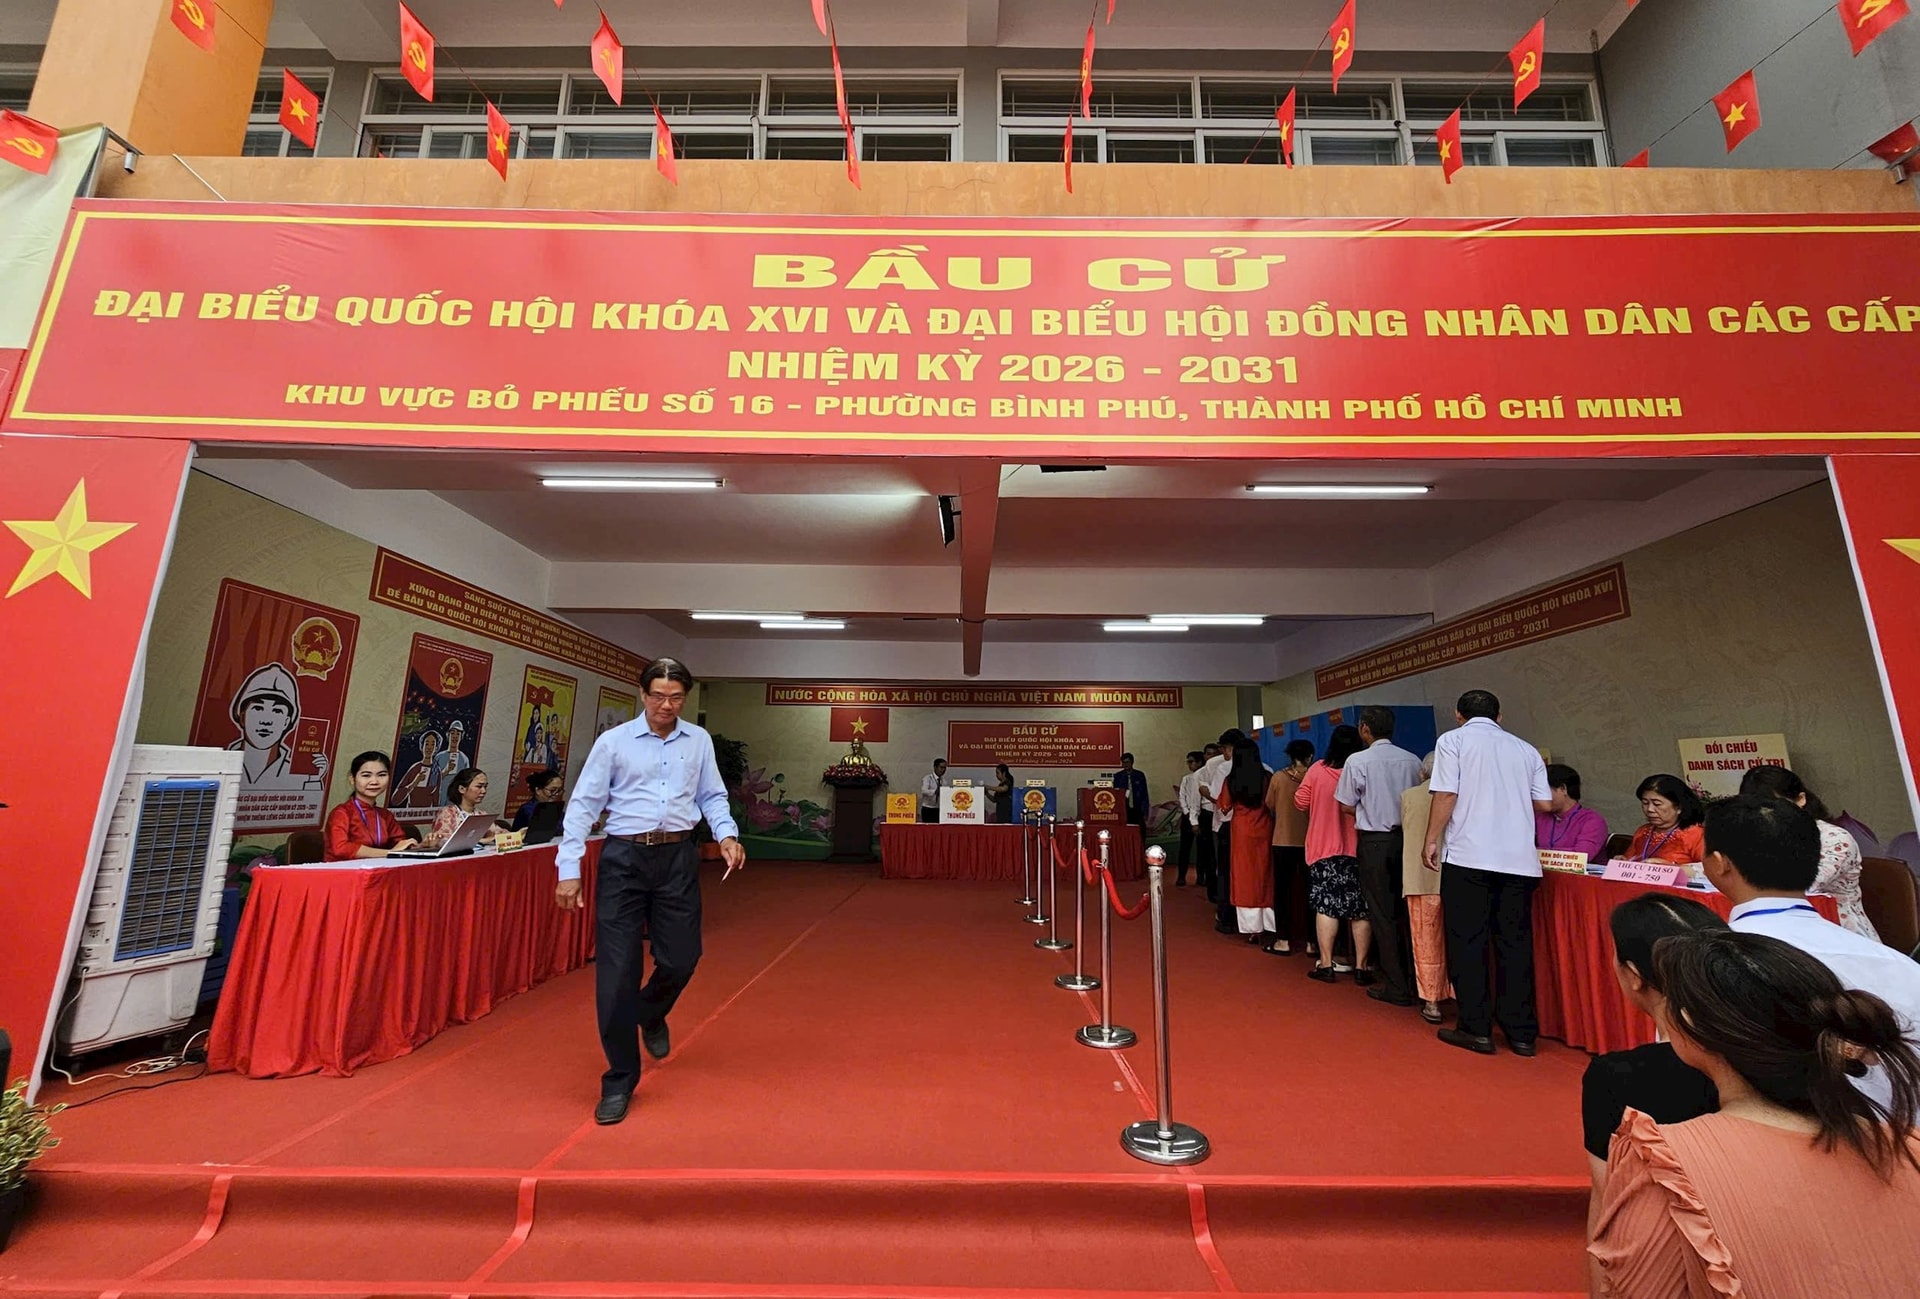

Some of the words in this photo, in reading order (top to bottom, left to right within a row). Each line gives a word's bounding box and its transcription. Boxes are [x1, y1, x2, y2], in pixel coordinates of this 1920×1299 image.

[753, 245, 1031, 291] BẦU
[1089, 247, 1286, 292] CỬ
[94, 290, 184, 323] ĐẠI
[198, 285, 318, 321] BIỂU
[335, 290, 473, 326] QUỐC
[489, 296, 575, 334] HỘI
[592, 299, 729, 331] KHÓA
[748, 306, 828, 332] XVI
[847, 302, 910, 334] VÀ
[928, 308, 1012, 340] ĐẠI
[1032, 299, 1146, 336] BIỂU
[1166, 304, 1248, 341] HỘI
[1268, 301, 1407, 337] ĐỒNG
[1425, 304, 1568, 336] NHÂN
[1585, 303, 1691, 335] DÂN
[1709, 301, 1810, 333] CÁC
[1827, 297, 1920, 332] CẤP
[728, 347, 899, 386] NHIỆM
[918, 348, 981, 382] KỲ
[1000, 354, 1125, 382] 2026
[1180, 356, 1297, 383] 2031
[285, 384, 366, 405] KHU
[380, 387, 454, 410] VỰC
[468, 384, 519, 409] BỎ
[532, 385, 648, 412] PHIẾU
[662, 389, 713, 414] SỐ
[731, 395, 773, 414] 16
[816, 393, 976, 417] PHƯỜNG
[991, 395, 1084, 418] BÌNH
[1099, 396, 1188, 420] PHÚ,
[1203, 395, 1330, 419] THÀNH
[1344, 393, 1421, 419] PHỐ
[1435, 393, 1486, 419] HỒ
[1500, 395, 1564, 418] CHÍ
[1577, 398, 1682, 418] MINH
[1514, 604, 1540, 622] QUỐC
[1594, 579, 1614, 595] XVI
[1493, 628, 1515, 643] 2026
[1522, 618, 1549, 635] 2031!
[775, 689, 813, 700] NƯỚC
[817, 688, 855, 703] CỘNG
[859, 689, 888, 701] HÒA
[892, 690, 910, 701] XÃ
[914, 691, 937, 703] HỘI
[941, 690, 970, 701] CHỦ
[973, 691, 1016, 702] NGHĨA
[1020, 690, 1050, 704] VIỆT
[1053, 692, 1086, 702] NAM
[1090, 691, 1132, 703] MUÔN
[1136, 691, 1174, 703] NĂM!
[1012, 724, 1037, 735] BẦU
[1041, 724, 1059, 735] CỬ
[1705, 740, 1724, 754] ĐỐI
[1726, 738, 1758, 753] CHIẾU
[1688, 760, 1714, 771] DANH
[1717, 758, 1745, 771] SÁCH
[1621, 871, 1637, 879] 001
[1644, 874, 1661, 882] 750
